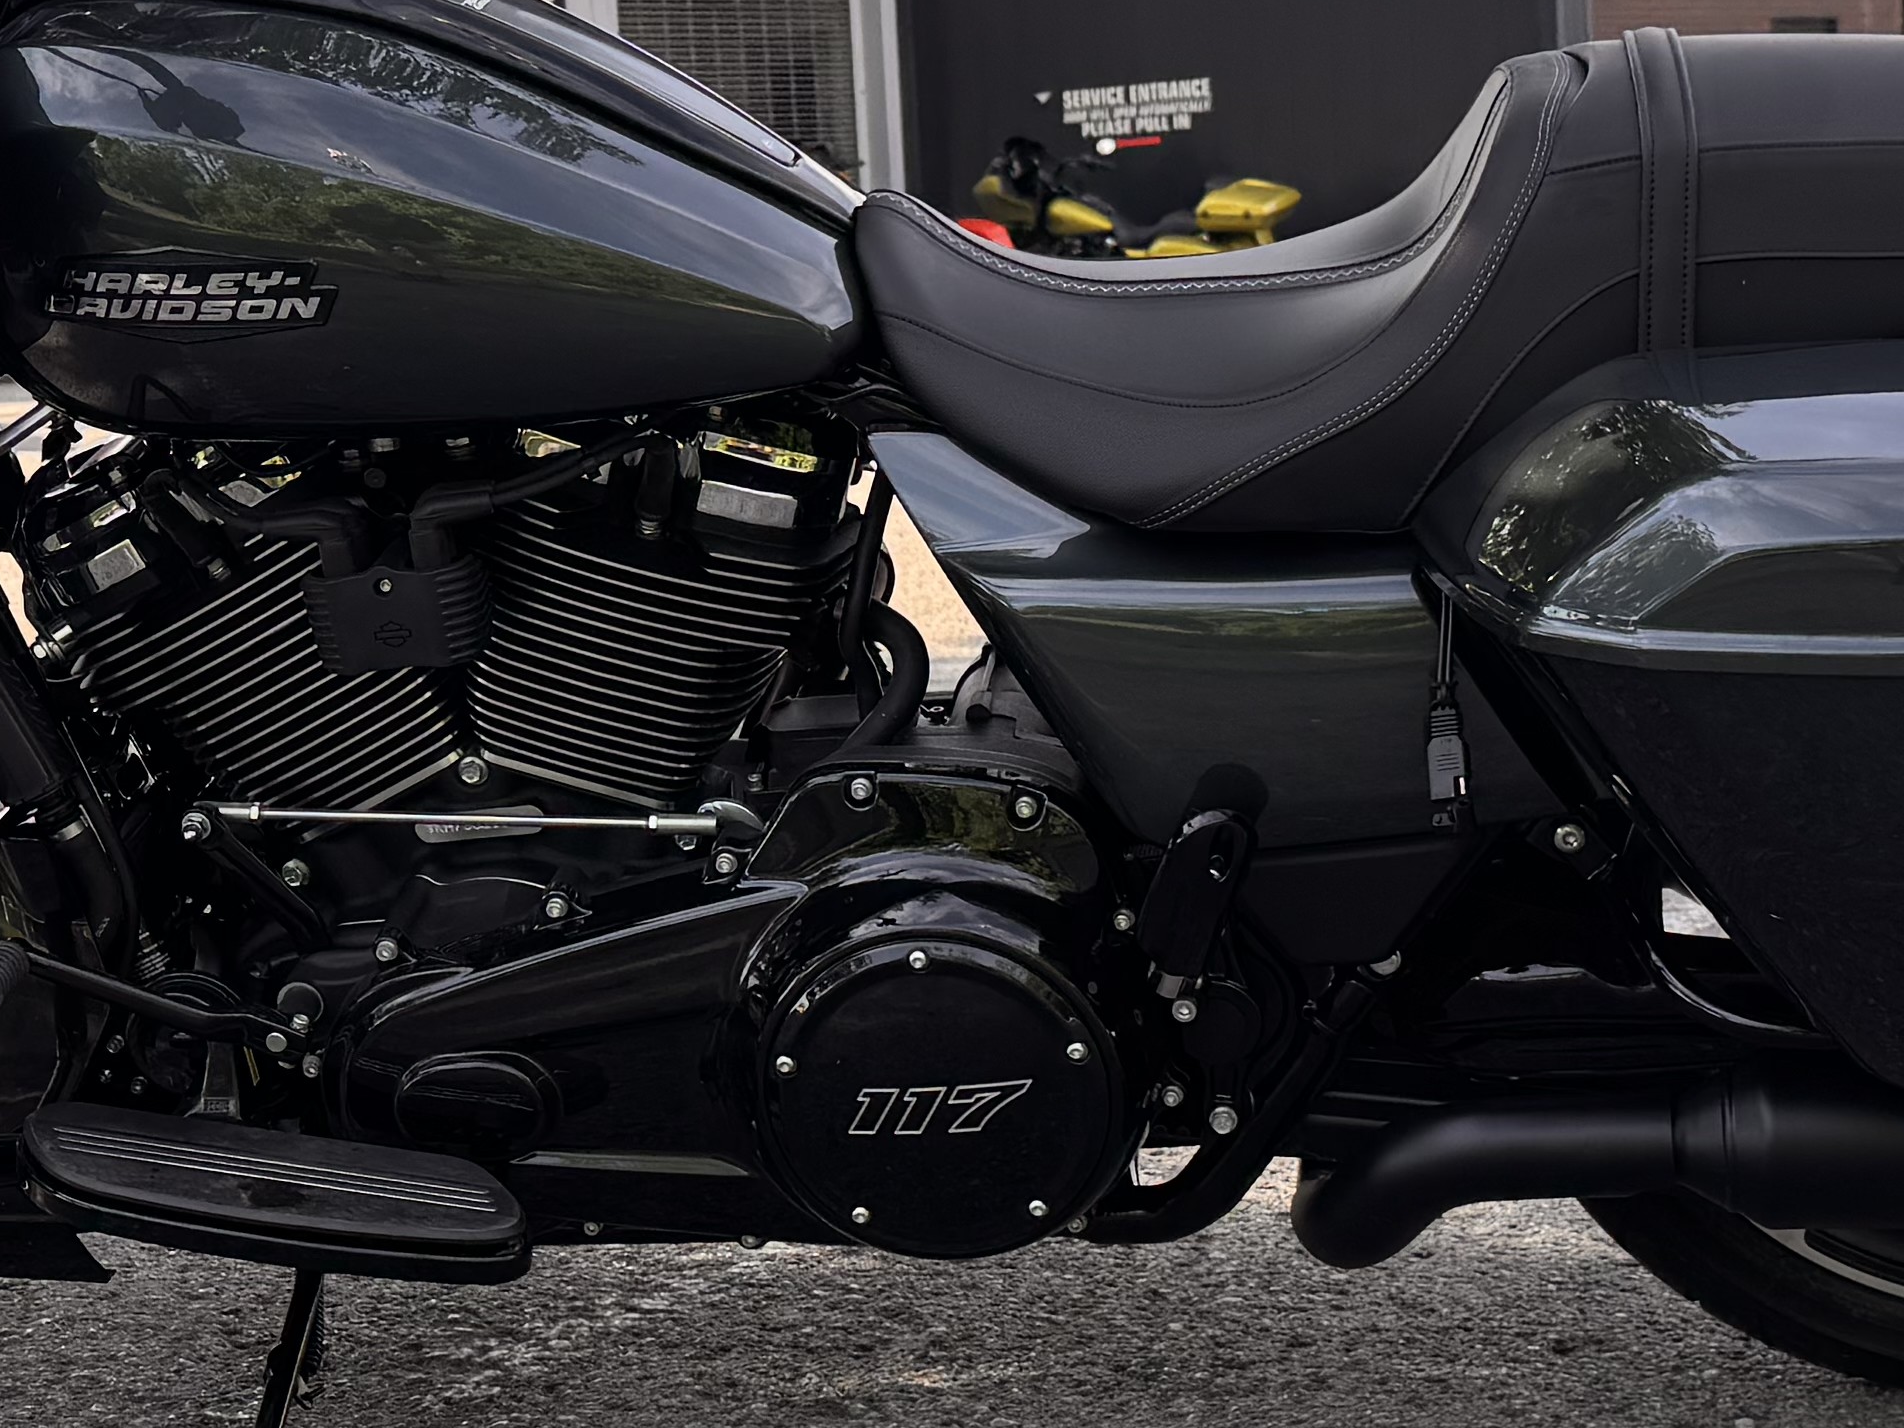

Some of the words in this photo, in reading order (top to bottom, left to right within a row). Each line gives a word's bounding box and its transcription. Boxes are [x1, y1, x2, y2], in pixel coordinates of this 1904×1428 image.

[1062, 86, 1125, 109] SERVICE
[1129, 77, 1210, 103] ENTRANCE
[1081, 118, 1132, 138] PLEASE
[1135, 115, 1170, 133] PULL
[1173, 113, 1192, 130] IN
[63, 270, 301, 295] HARLEY-
[46, 295, 321, 321] DAVIDSON
[847, 1079, 1033, 1135] 117
